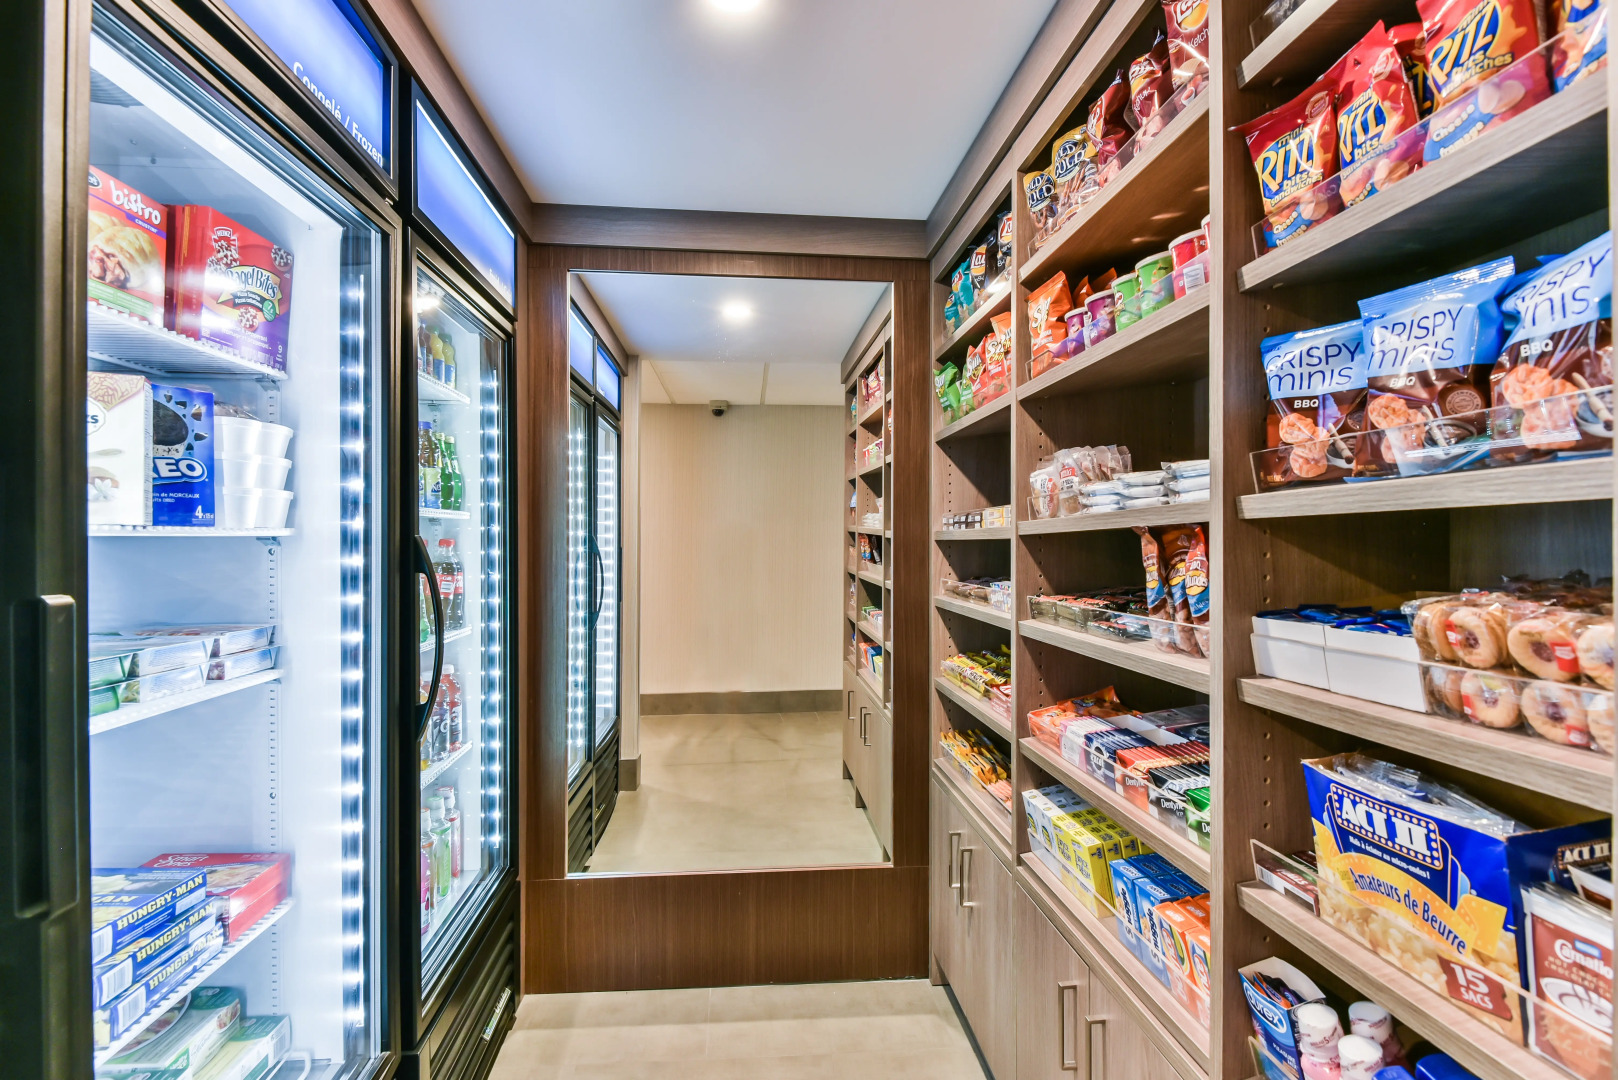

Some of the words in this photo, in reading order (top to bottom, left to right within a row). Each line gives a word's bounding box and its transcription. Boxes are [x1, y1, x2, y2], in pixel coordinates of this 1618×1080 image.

[1428, 2, 1498, 85] RITZ
[1277, 124, 1305, 149] mini
[1338, 97, 1385, 163] RITZ
[1432, 103, 1476, 143] Cheese
[352, 122, 384, 167] Frozen
[1354, 137, 1379, 160] bits
[1256, 132, 1315, 193] RITZ
[1270, 172, 1323, 208] sandwiches
[1283, 172, 1308, 190] bits
[109, 179, 162, 226] bistro
[1347, 183, 1373, 208] Cheese
[216, 229, 232, 238] HEINZ
[1273, 210, 1299, 235] Cheese
[255, 271, 279, 300] Bites
[1370, 304, 1465, 347] CRISPY
[1265, 341, 1361, 373] CRISPY
[1367, 337, 1455, 371] minis
[1520, 340, 1554, 358] BBQ
[1268, 366, 1354, 392] minis
[1389, 376, 1416, 389] BBQ
[1293, 399, 1320, 409] BBQ
[152, 458, 204, 479] EO
[194, 504, 204, 519] 4
[1160, 798, 1184, 812] Dentyne
[1341, 797, 1390, 840] ACT
[1391, 816, 1432, 857] II
[1563, 845, 1591, 864] ACT
[116, 874, 204, 932] HUNGRY-MAN
[1349, 866, 1402, 904] Amateurs
[1403, 891, 1419, 915] de
[1421, 901, 1467, 955] Beurre
[136, 902, 215, 963] HUNGRY-MAN
[1547, 955, 1568, 969] HOT
[1450, 963, 1490, 994] 15
[1461, 990, 1494, 1010] SACS
